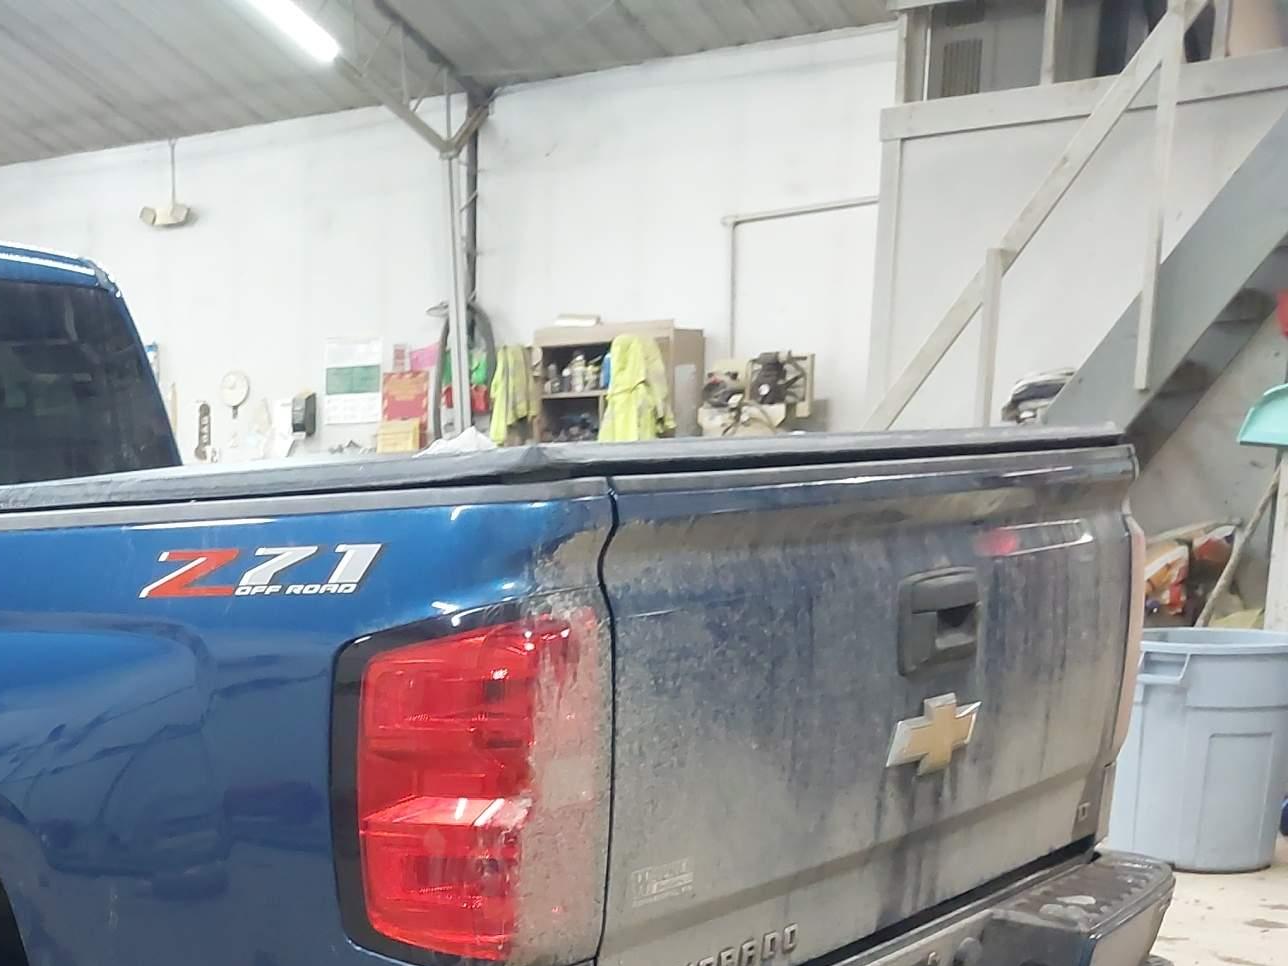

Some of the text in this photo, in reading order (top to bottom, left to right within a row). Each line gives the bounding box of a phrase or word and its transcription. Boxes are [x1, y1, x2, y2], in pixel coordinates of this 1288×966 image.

[139, 543, 383, 599] Z71
[234, 583, 359, 597] OFF ROAD
